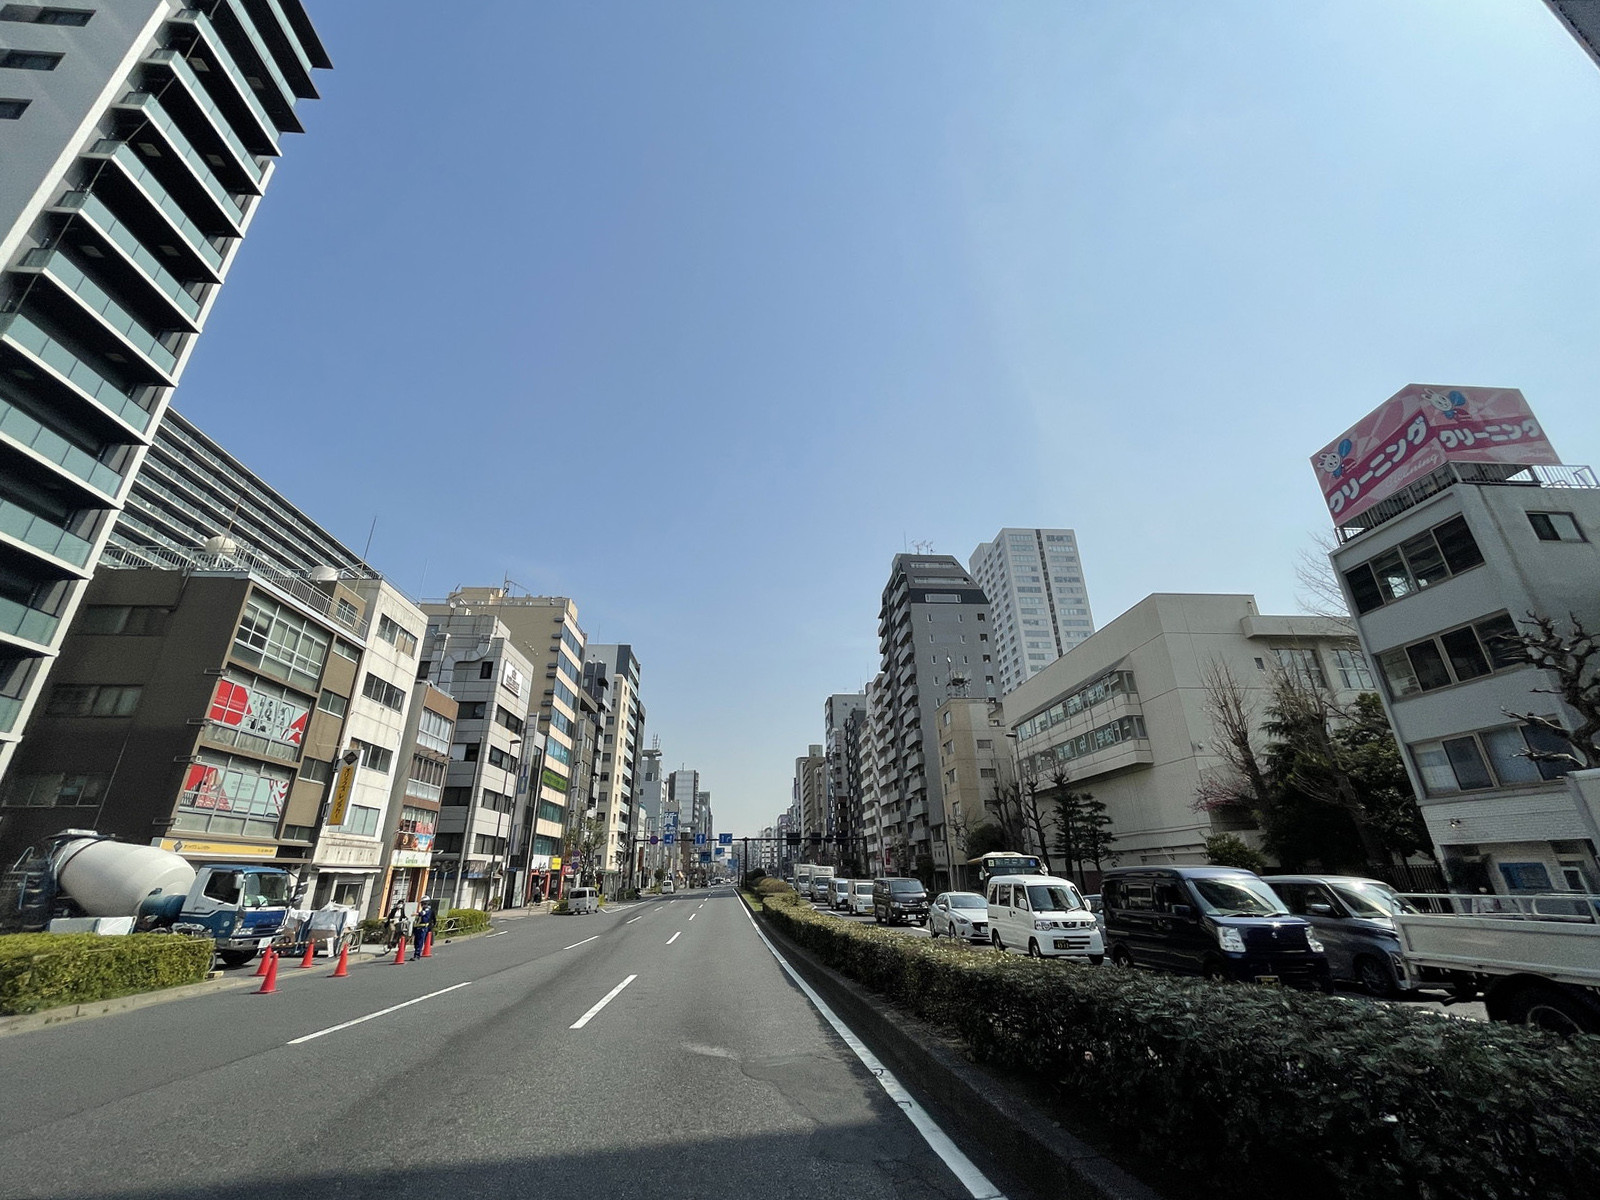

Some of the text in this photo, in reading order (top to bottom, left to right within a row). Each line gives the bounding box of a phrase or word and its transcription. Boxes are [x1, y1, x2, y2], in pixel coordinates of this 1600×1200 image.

[1329, 416, 1428, 513] クリーニング
